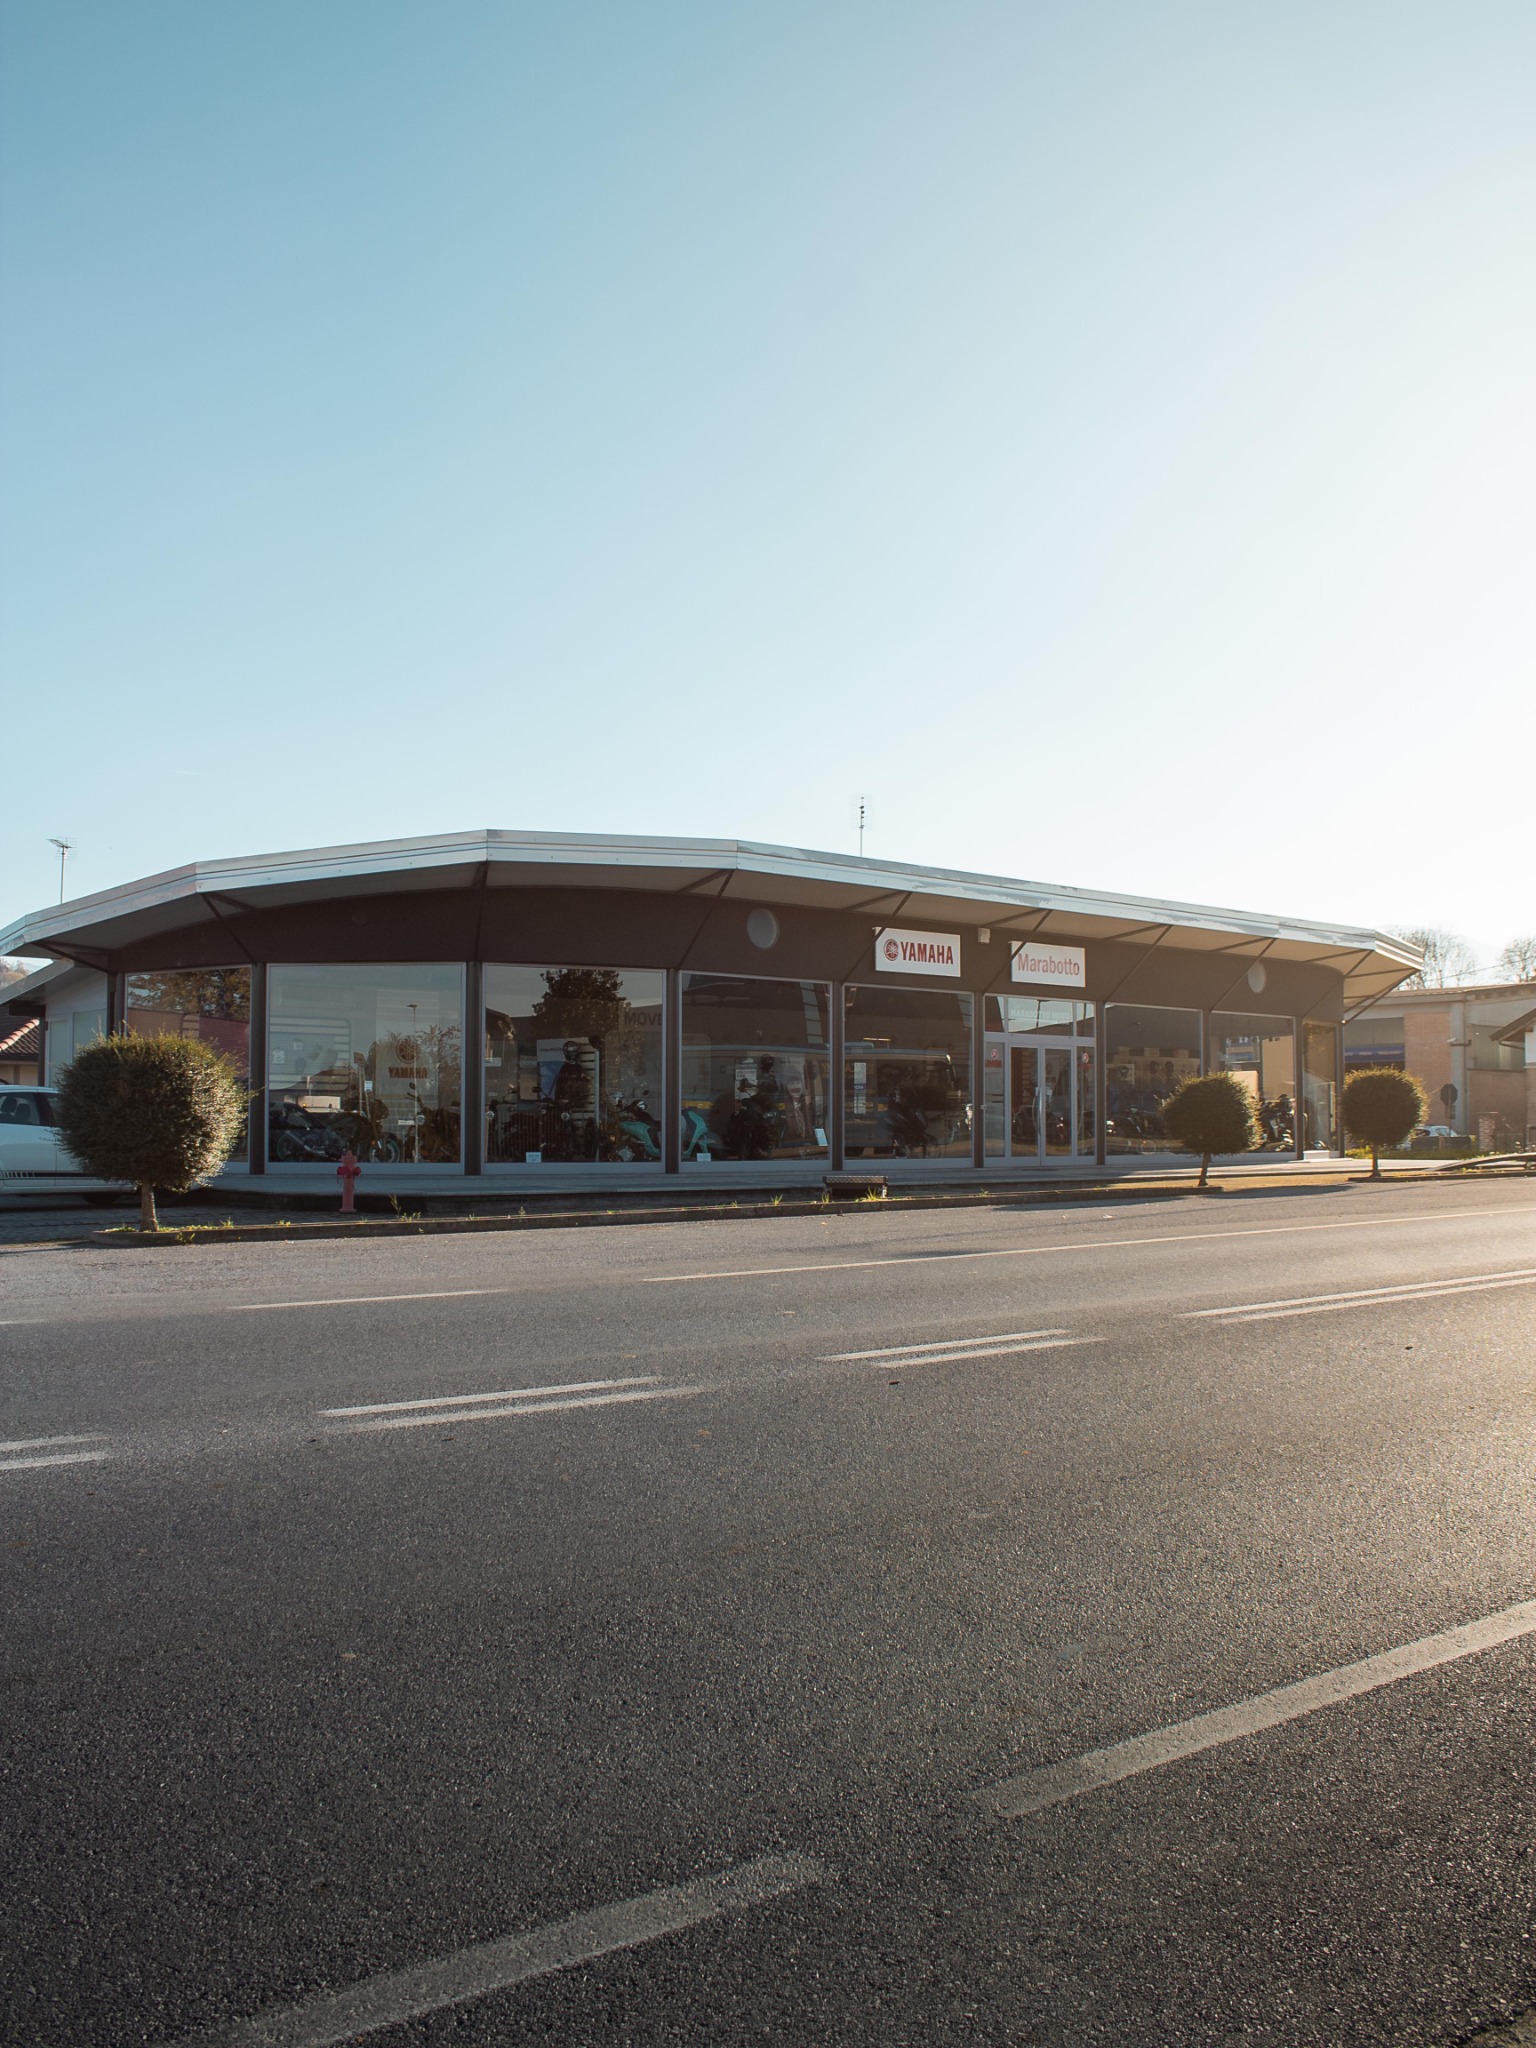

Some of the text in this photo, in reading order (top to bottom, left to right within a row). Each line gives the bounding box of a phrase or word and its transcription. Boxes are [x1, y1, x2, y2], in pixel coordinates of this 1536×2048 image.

[901, 941, 954, 965] YAMAHA
[1017, 953, 1080, 976] Marabotto
[388, 1066, 428, 1079] YAMAHA
